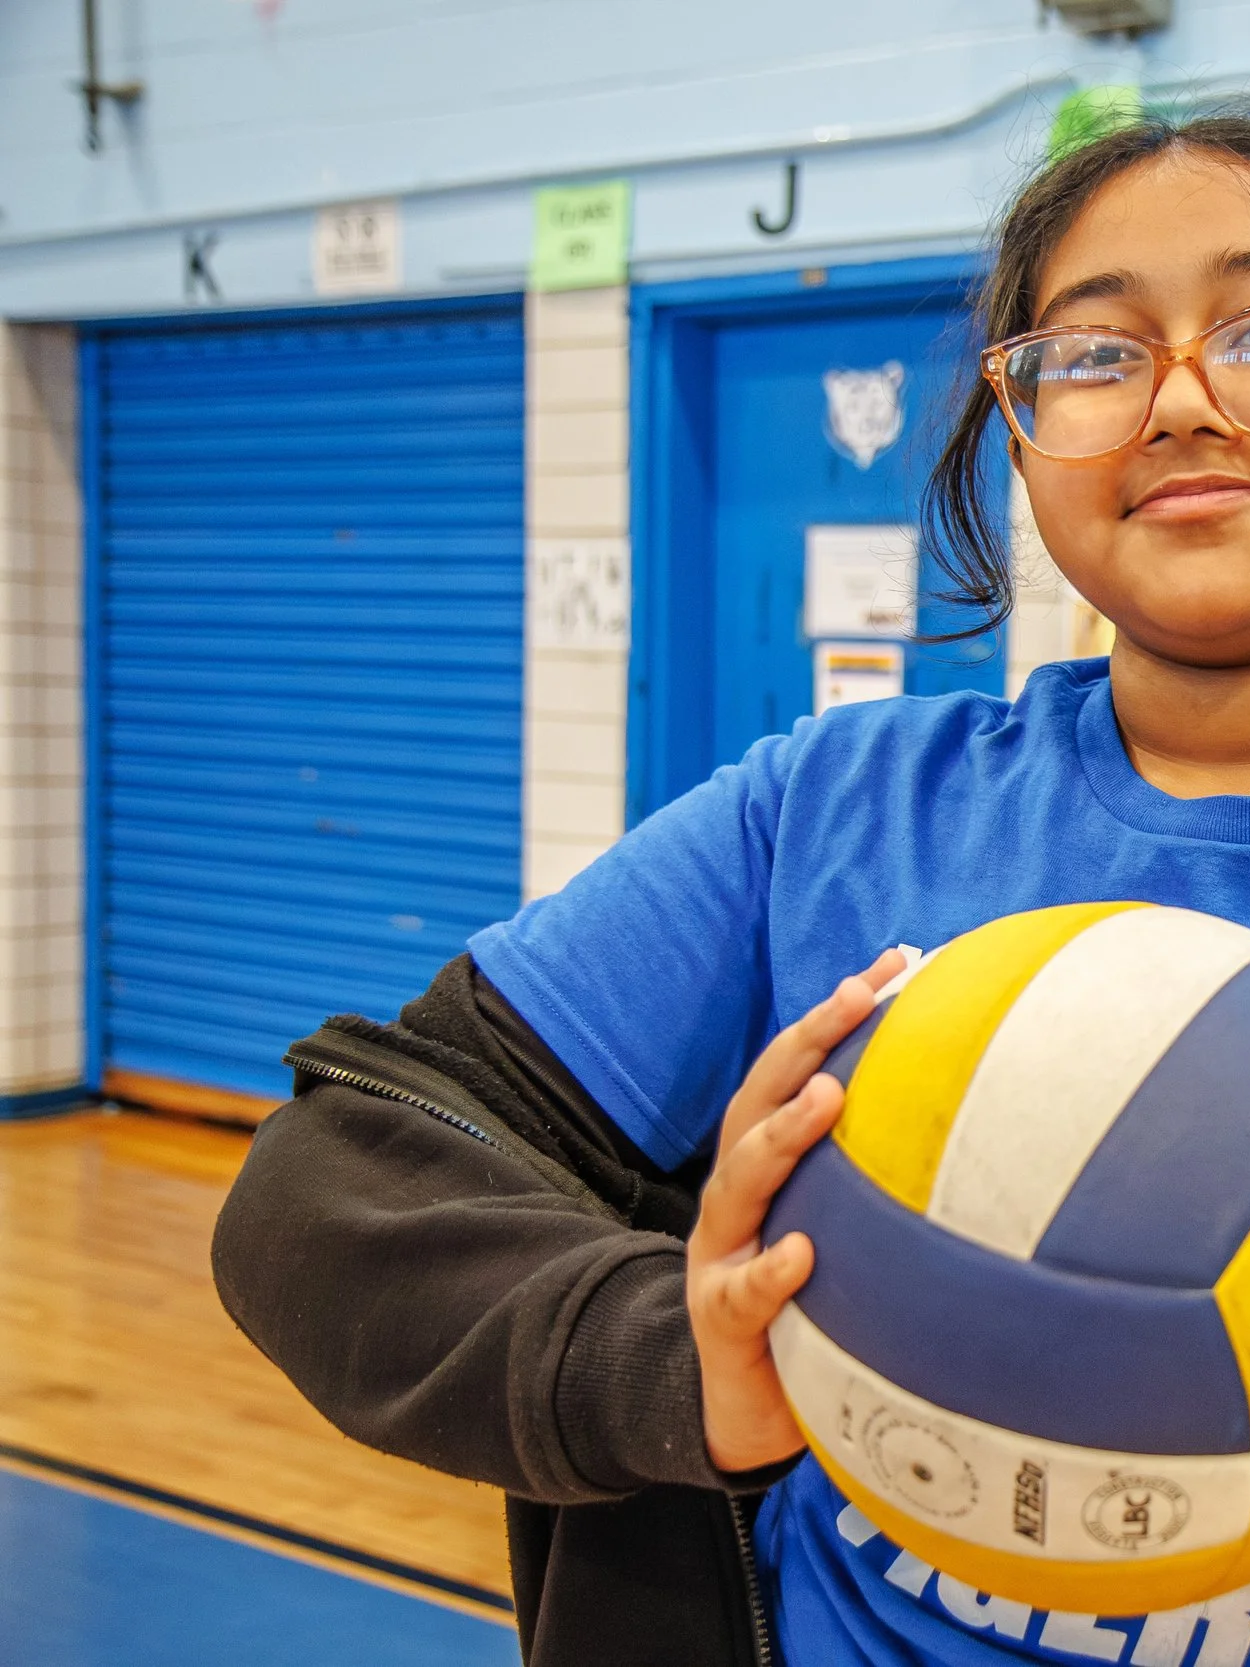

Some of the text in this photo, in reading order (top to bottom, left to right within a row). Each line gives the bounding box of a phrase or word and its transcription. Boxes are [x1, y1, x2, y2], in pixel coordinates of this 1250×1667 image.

[749, 163, 798, 239] J
[182, 231, 226, 305] K
[1121, 1492, 1152, 1539] LBC
